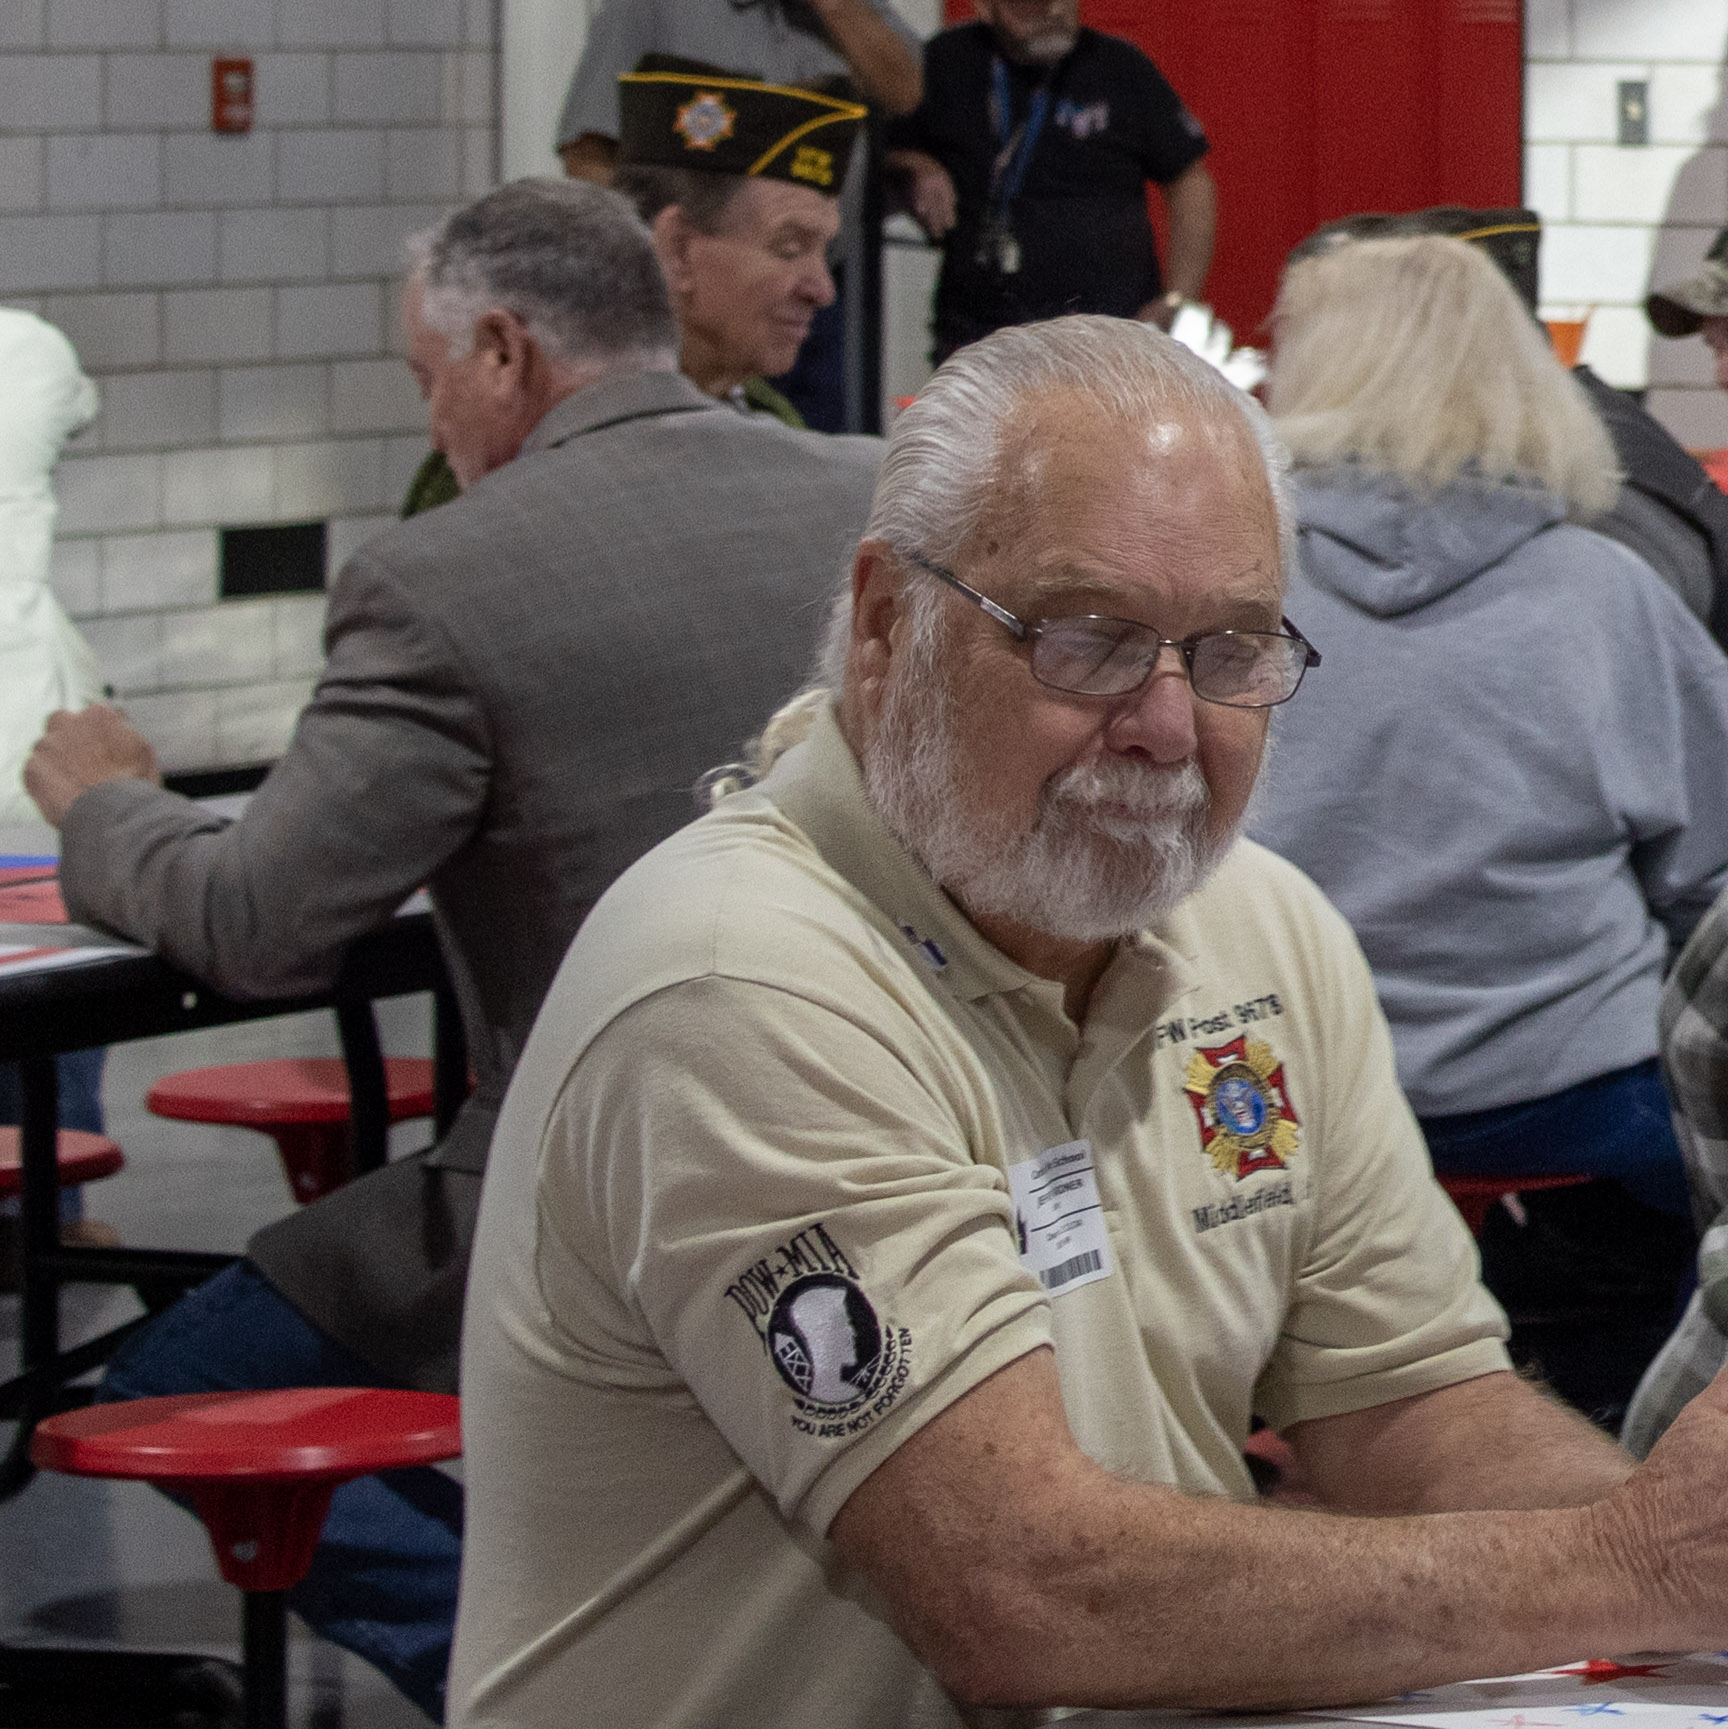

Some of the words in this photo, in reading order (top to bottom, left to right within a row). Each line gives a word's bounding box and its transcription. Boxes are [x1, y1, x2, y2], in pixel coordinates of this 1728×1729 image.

[791, 1414, 816, 1436] YOU
[818, 1423, 846, 1438] ARE
[849, 1411, 875, 1433] NOT
[873, 1327, 913, 1416] FORGOTTEN
